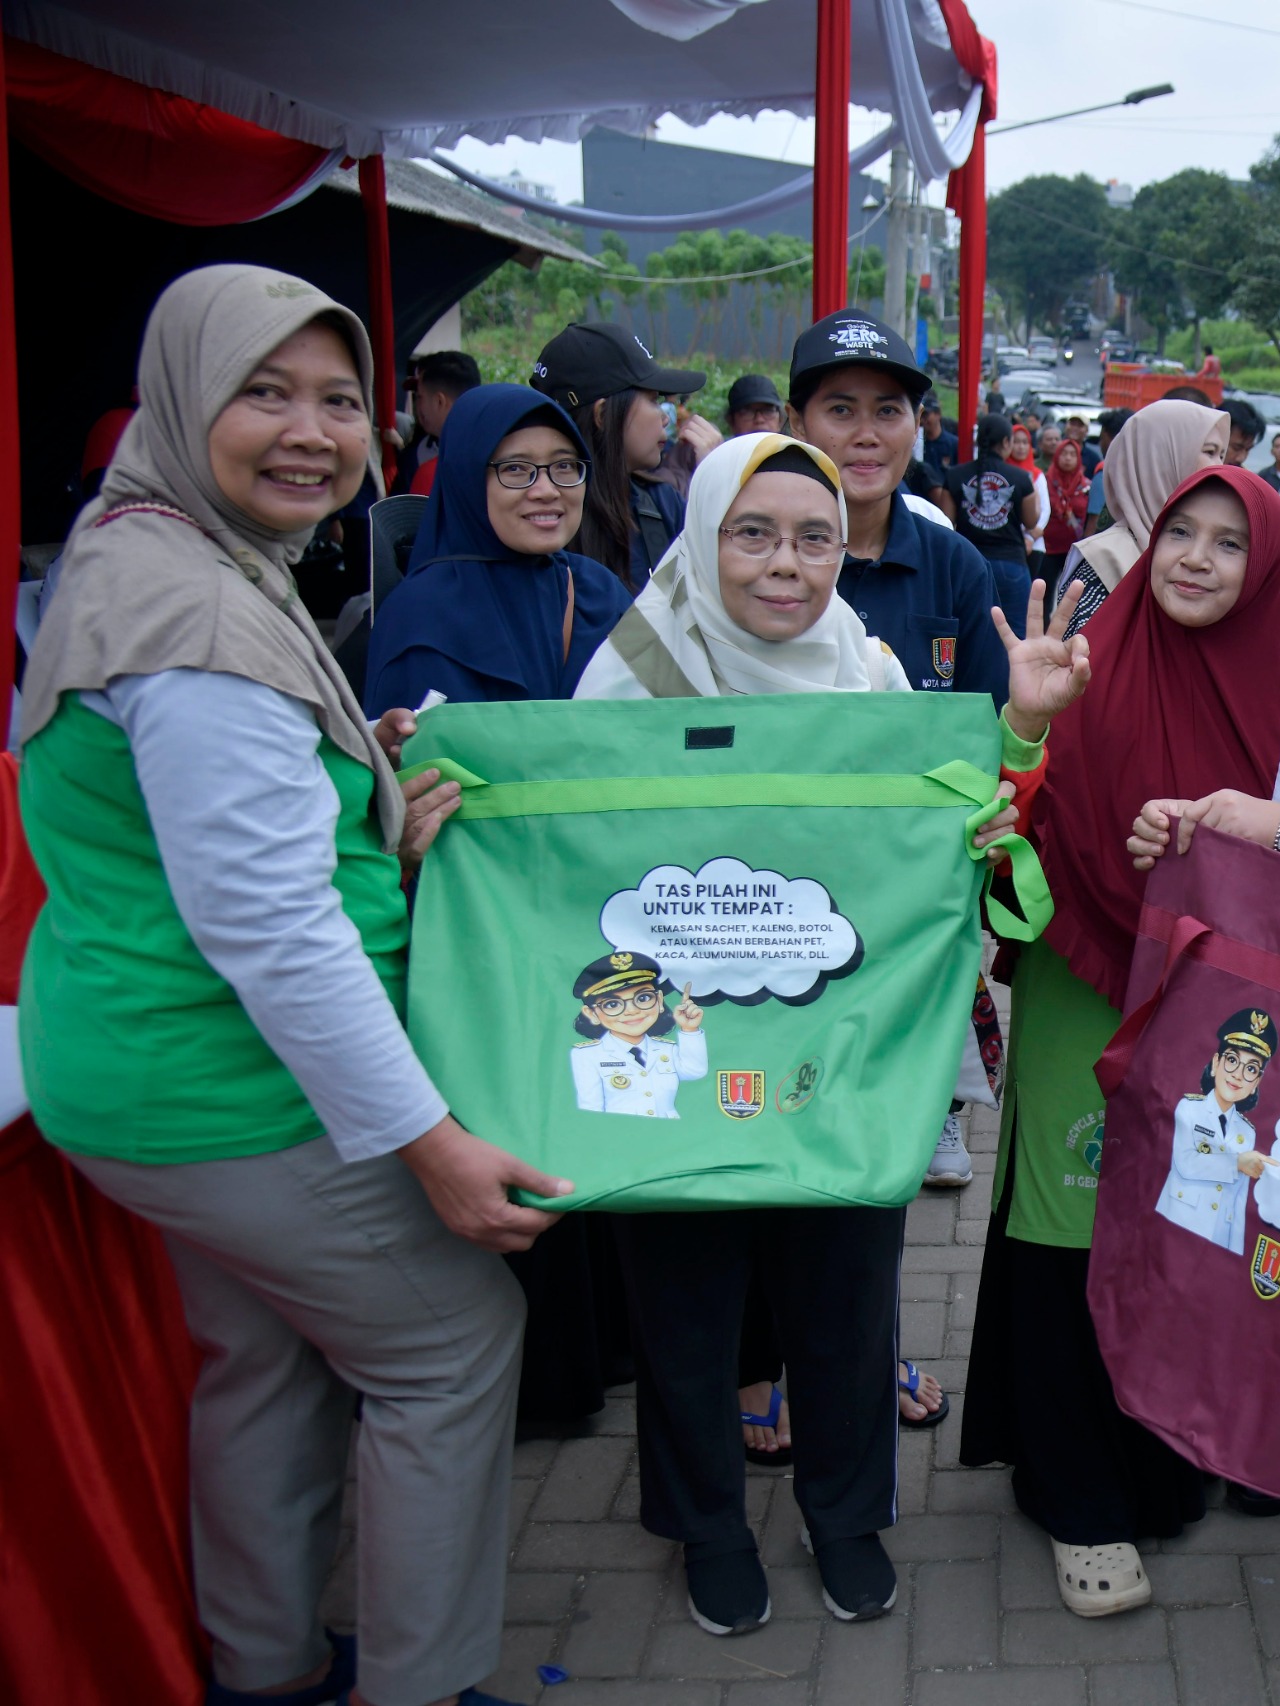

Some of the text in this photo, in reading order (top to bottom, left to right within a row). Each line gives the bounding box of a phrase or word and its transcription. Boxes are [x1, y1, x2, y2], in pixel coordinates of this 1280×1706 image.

[837, 329, 880, 344] ZERO
[846, 341, 874, 349] WASTE
[922, 679, 939, 688] KOTA
[655, 884, 777, 898] TAS PILAH INI
[643, 901, 706, 916] UNTUK
[710, 901, 784, 915] TEMPAT
[650, 924, 834, 934] KEMASAN SACHET, KALENG, BOTOL
[659, 937, 826, 946] ATAU KEMASAN BERBAHAN PET,
[655, 950, 830, 960] KACA, ALUMUNIUM, PLASTIK, DLL.
[1066, 1112, 1097, 1150] RECYCLE
